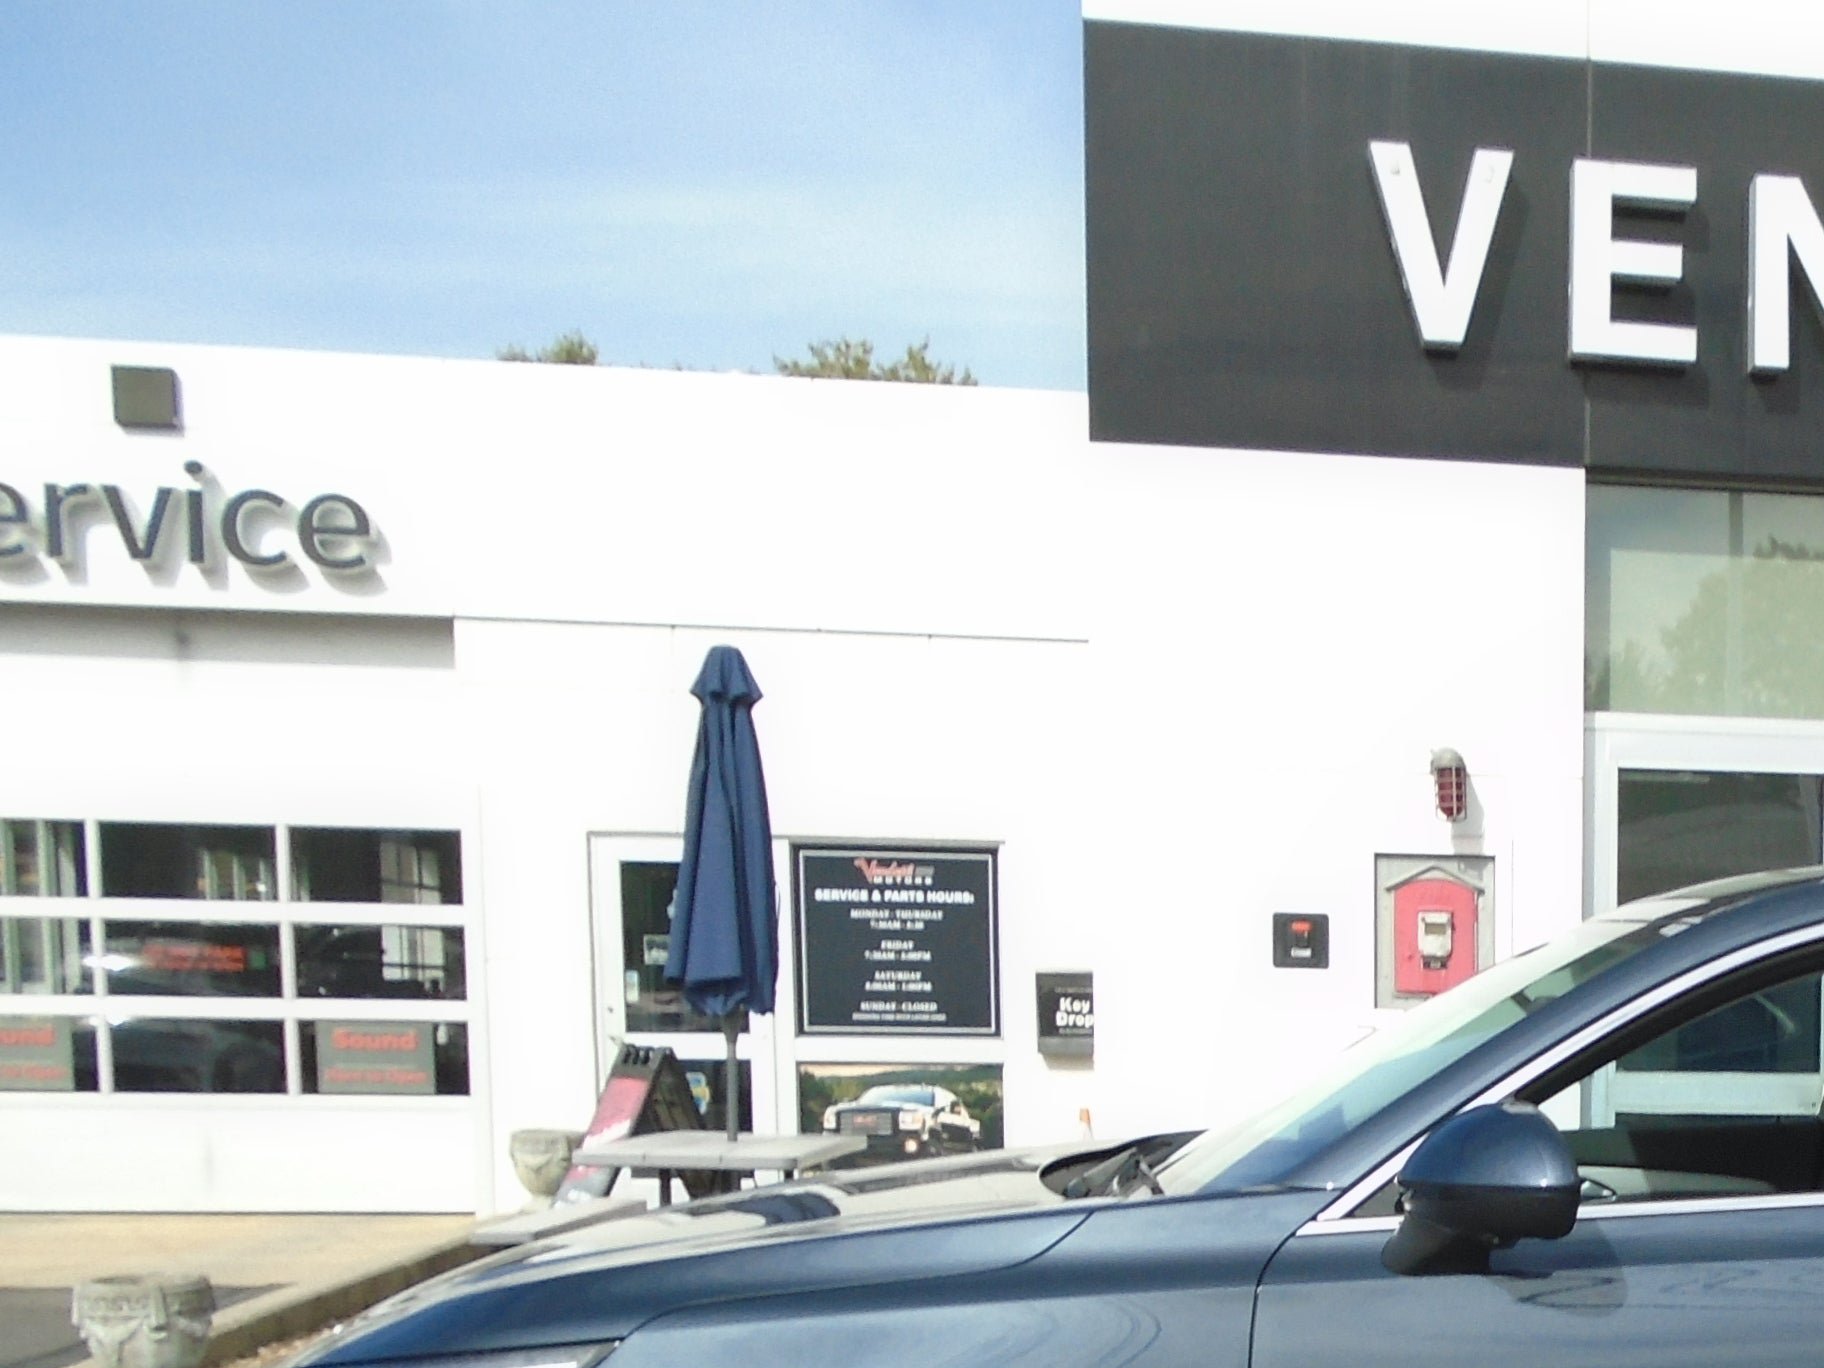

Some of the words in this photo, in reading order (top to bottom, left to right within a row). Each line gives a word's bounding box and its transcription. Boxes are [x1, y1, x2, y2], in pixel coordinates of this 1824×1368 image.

[814, 888, 869, 902] SERVICE
[871, 890, 881, 902] &
[884, 890, 925, 903] PARTS
[927, 890, 974, 904] HOURS:
[1060, 996, 1090, 1015] Key
[1056, 1010, 1094, 1028] Drop
[332, 1028, 418, 1051] Sound
